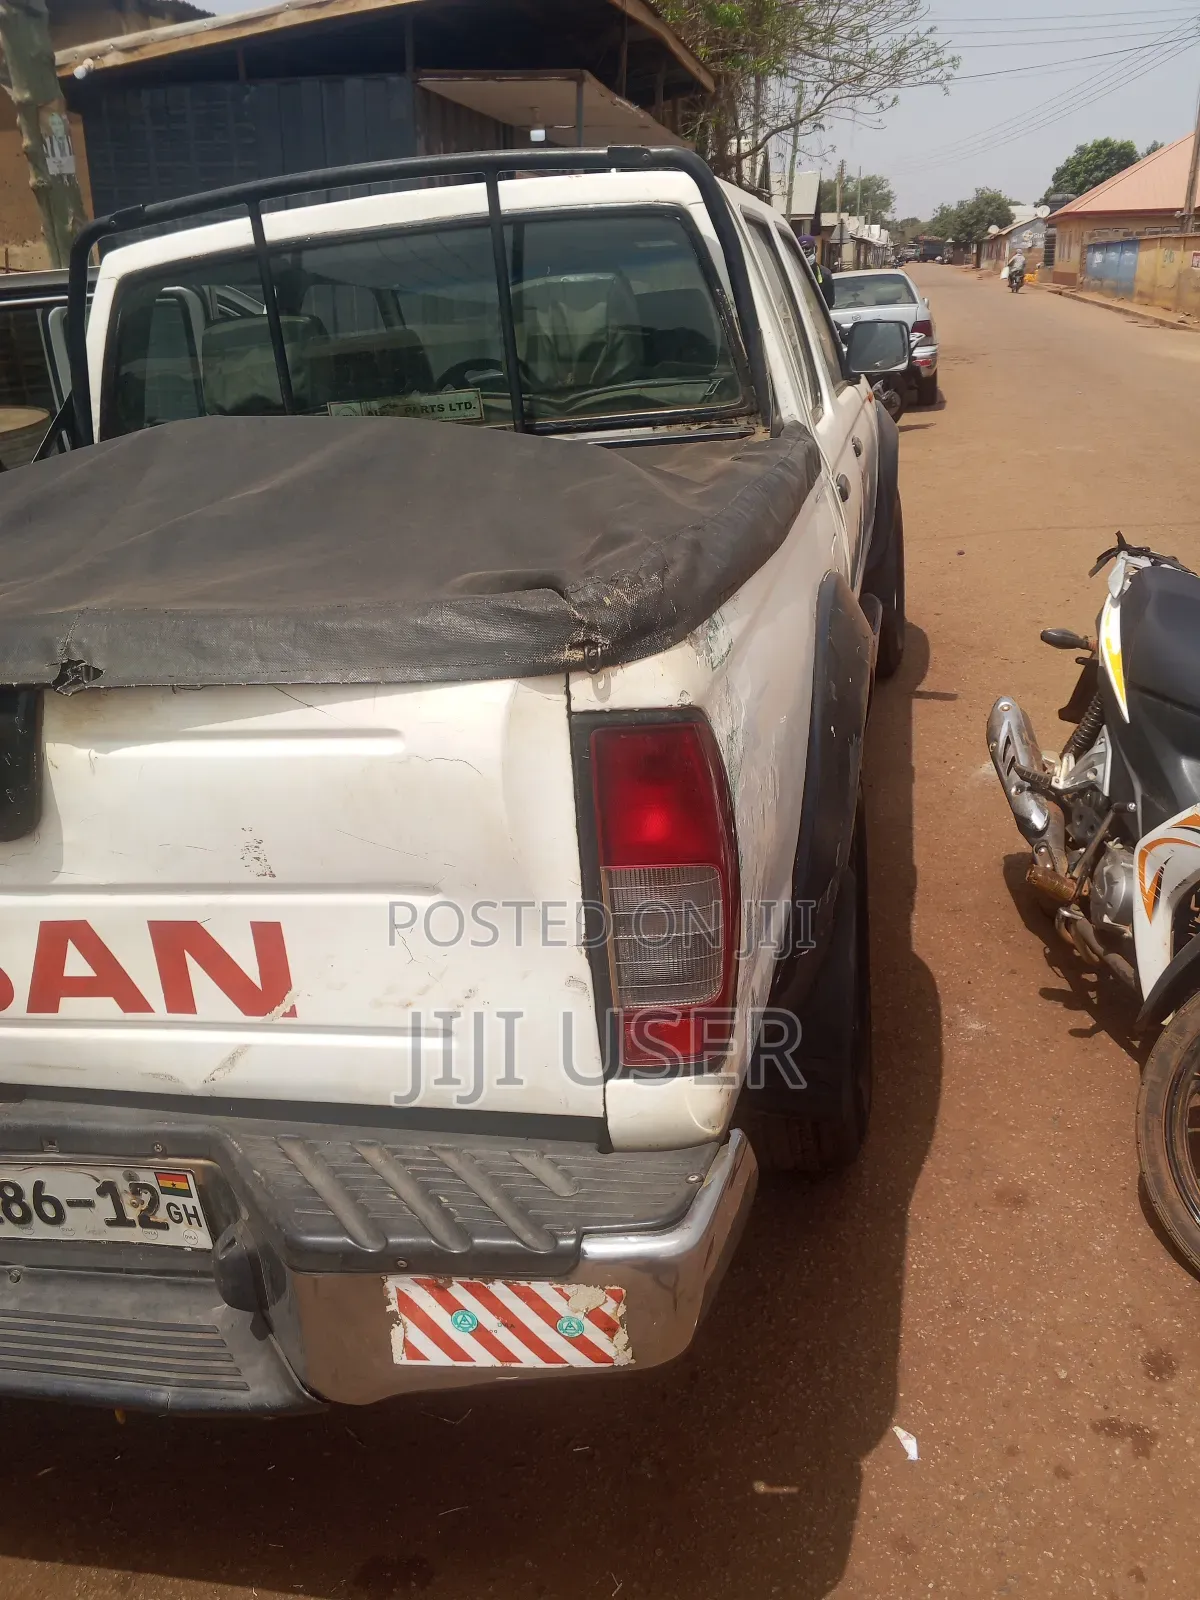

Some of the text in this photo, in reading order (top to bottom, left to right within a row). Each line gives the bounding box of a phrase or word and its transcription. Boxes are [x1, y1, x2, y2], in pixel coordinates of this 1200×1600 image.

[449, 401, 477, 412] LTD.
[0, 919, 298, 1018] AN
[0, 1178, 170, 1231] 86-12
[165, 1201, 203, 1228] GH
